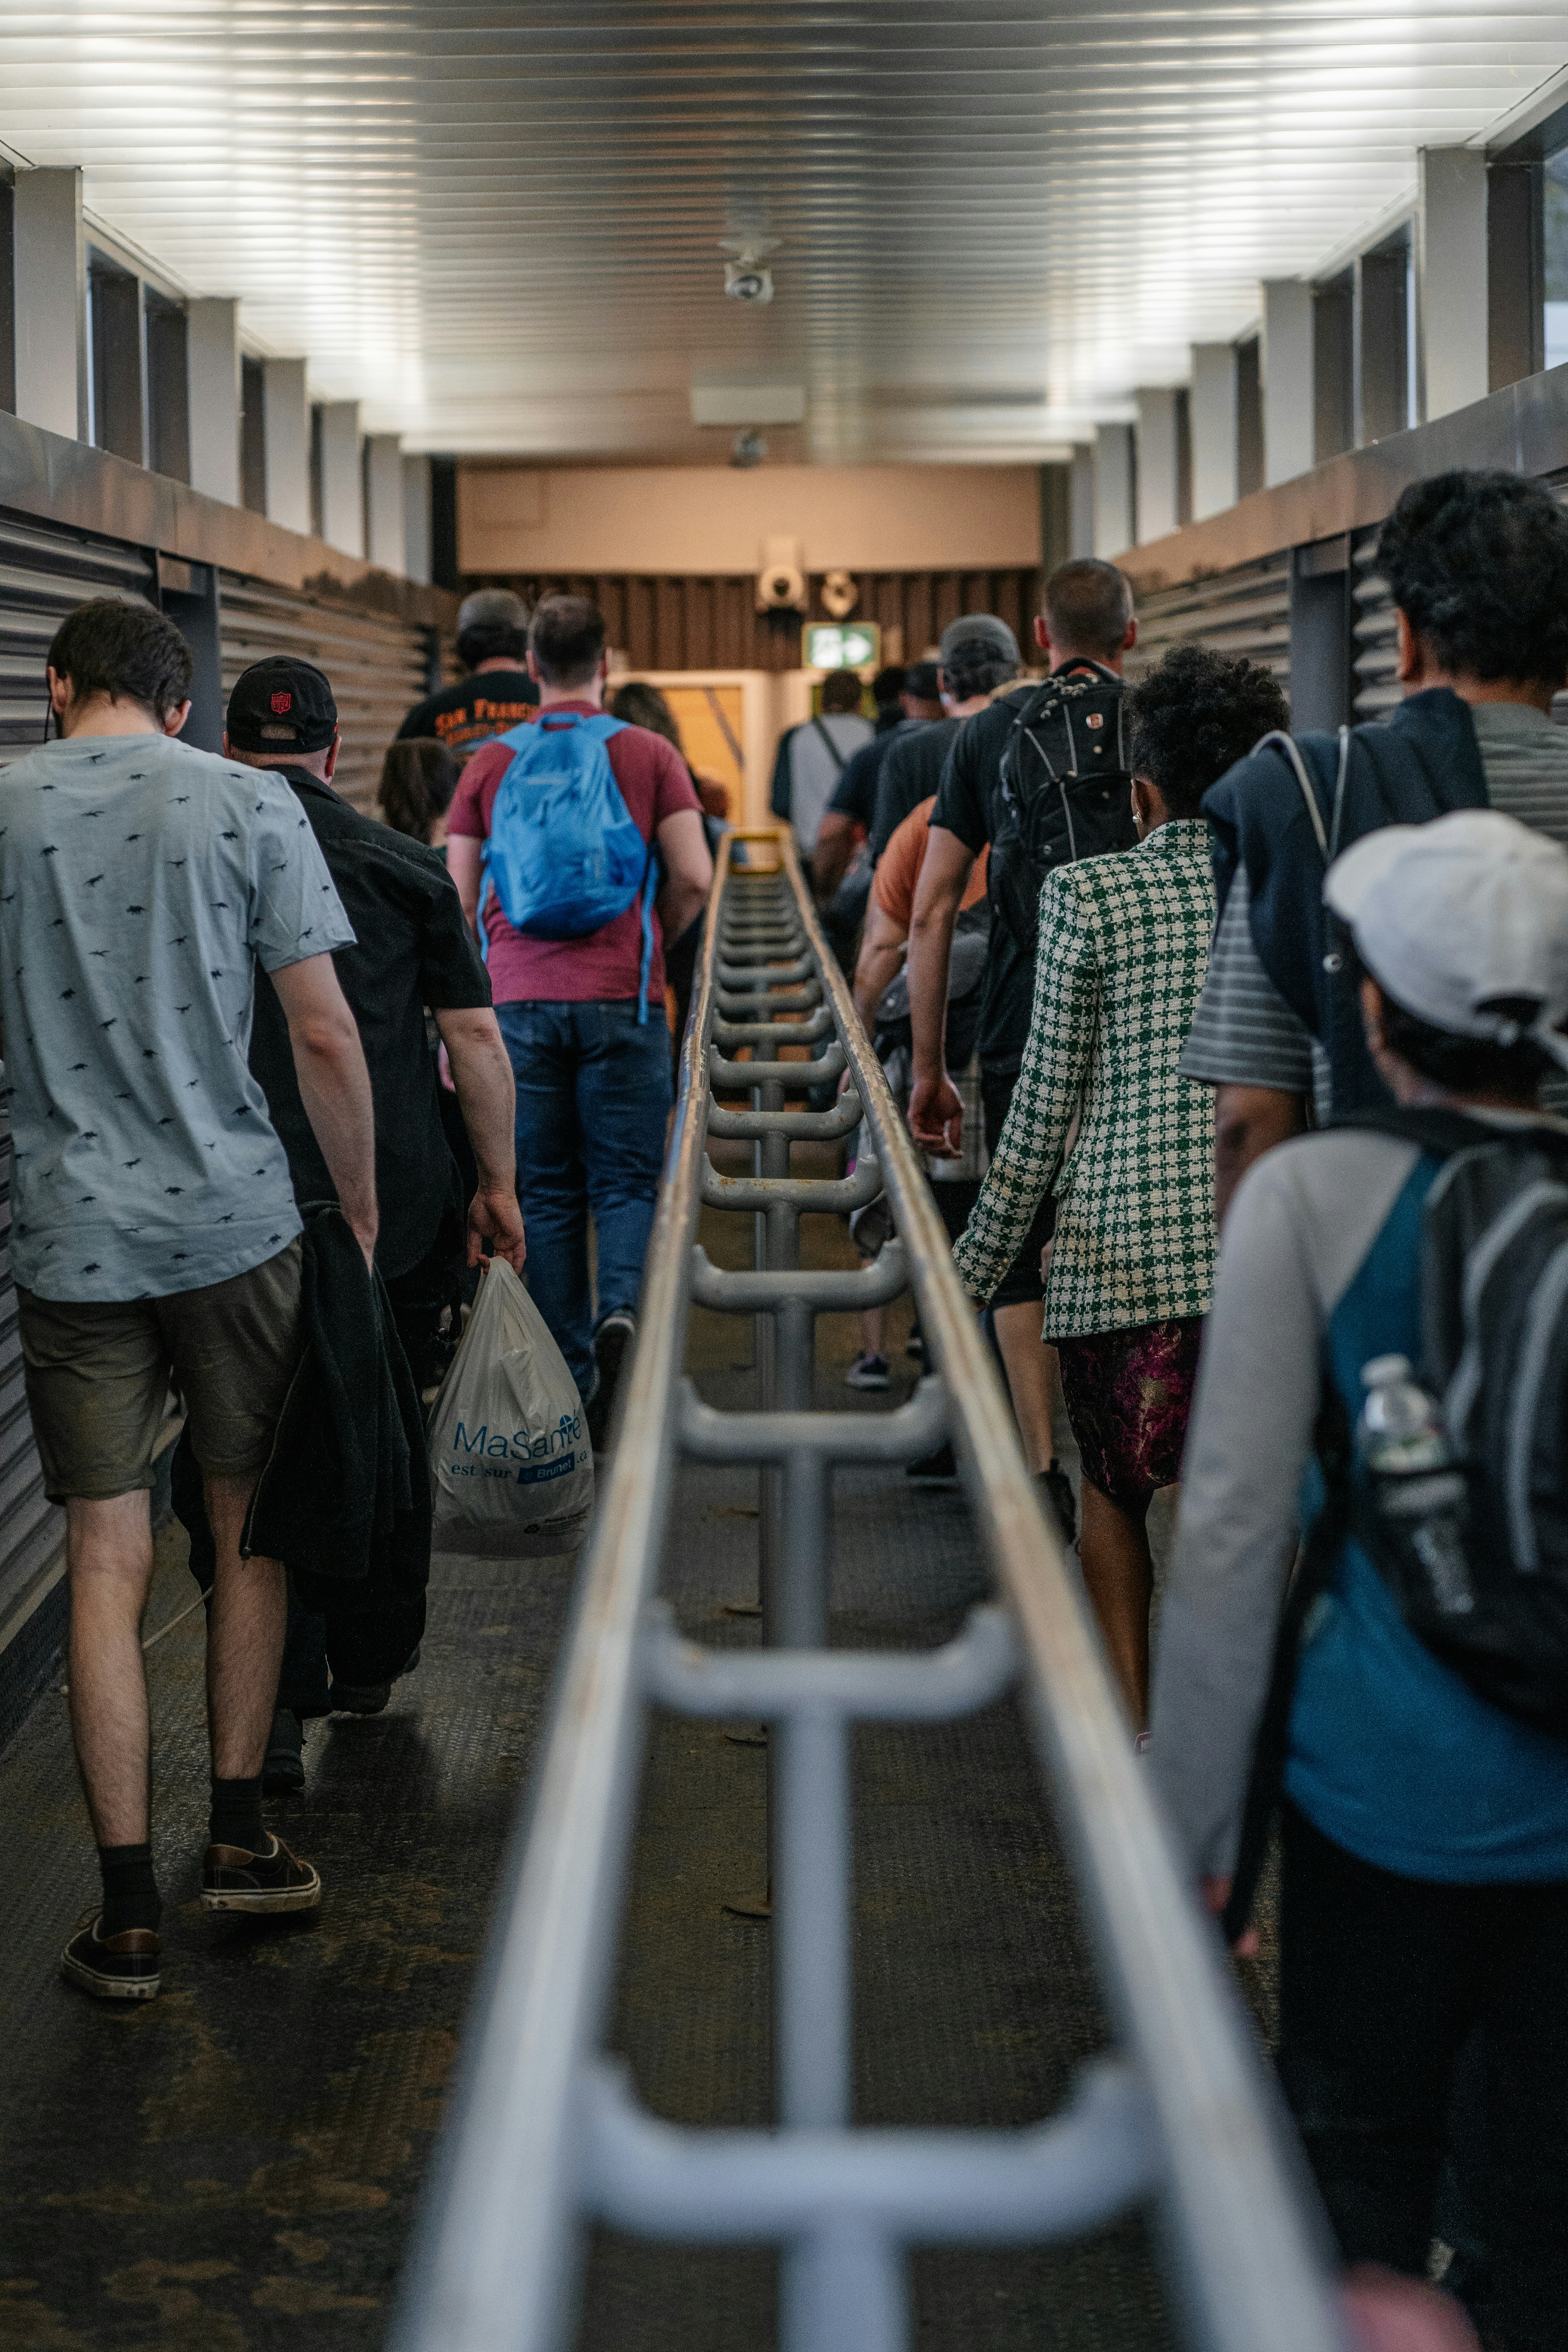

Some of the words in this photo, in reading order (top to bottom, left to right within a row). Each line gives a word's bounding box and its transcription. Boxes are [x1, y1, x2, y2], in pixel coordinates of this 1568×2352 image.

[453, 1409, 581, 1461] MaSanté
[451, 1463, 475, 1476] est
[484, 1466, 512, 1479] sur
